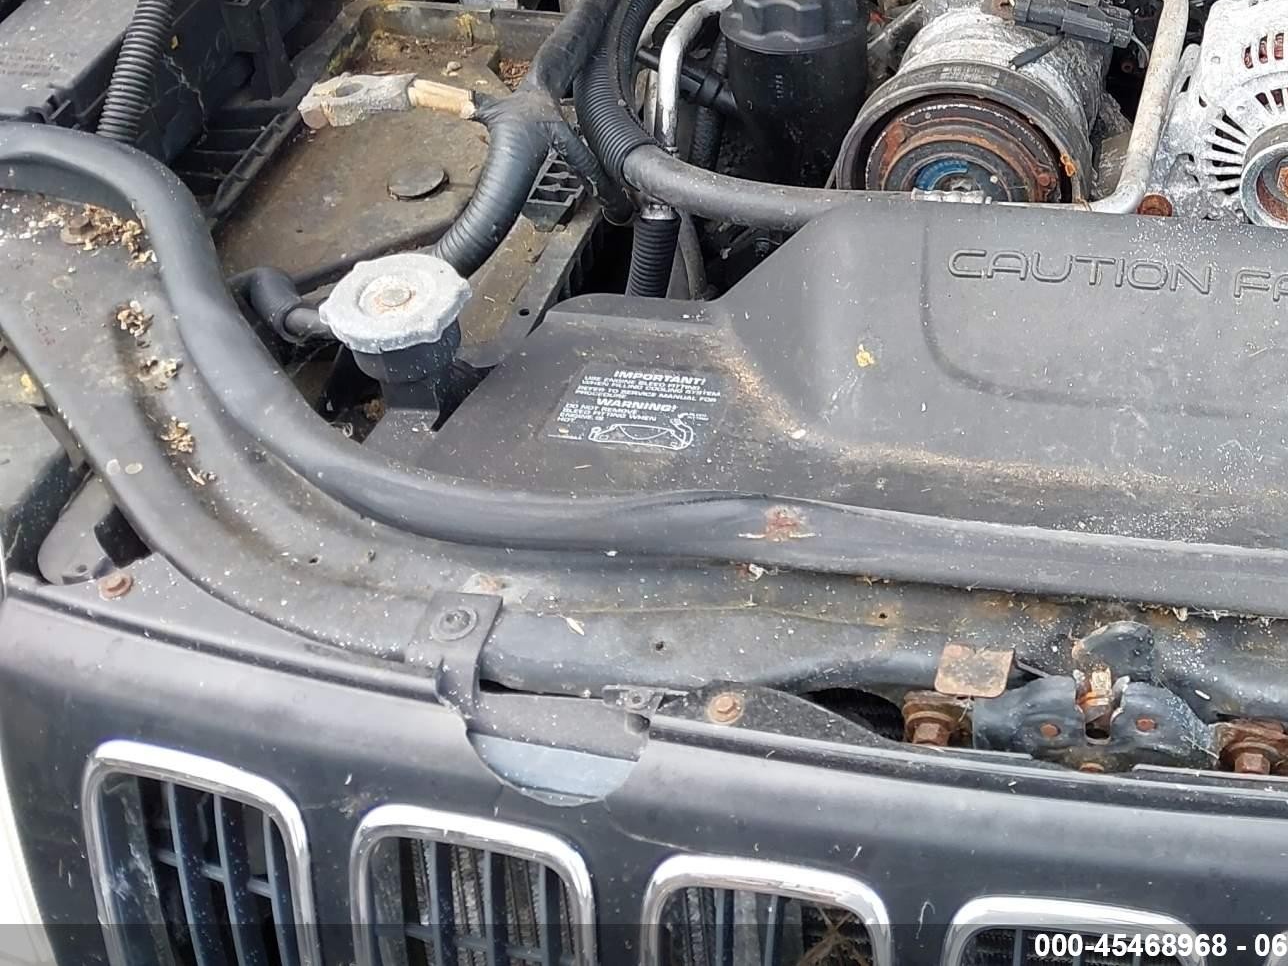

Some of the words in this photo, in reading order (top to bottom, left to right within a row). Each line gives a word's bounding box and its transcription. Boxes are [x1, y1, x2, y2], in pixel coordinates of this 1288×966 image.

[947, 248, 1213, 295] CAUTION
[603, 377, 635, 385] ENGINE
[667, 383, 701, 391] FITTING
[613, 370, 706, 385] IMPORTANT!
[611, 382, 644, 390] FILLING
[645, 386, 683, 394] COOLING
[684, 389, 720, 397] SYSTEM
[619, 389, 657, 397] SERVICE
[658, 393, 697, 401] MANUAL
[596, 398, 677, 412] WARNING!
[601, 406, 638, 415] REMOVE
[628, 413, 656, 421] WHEN
